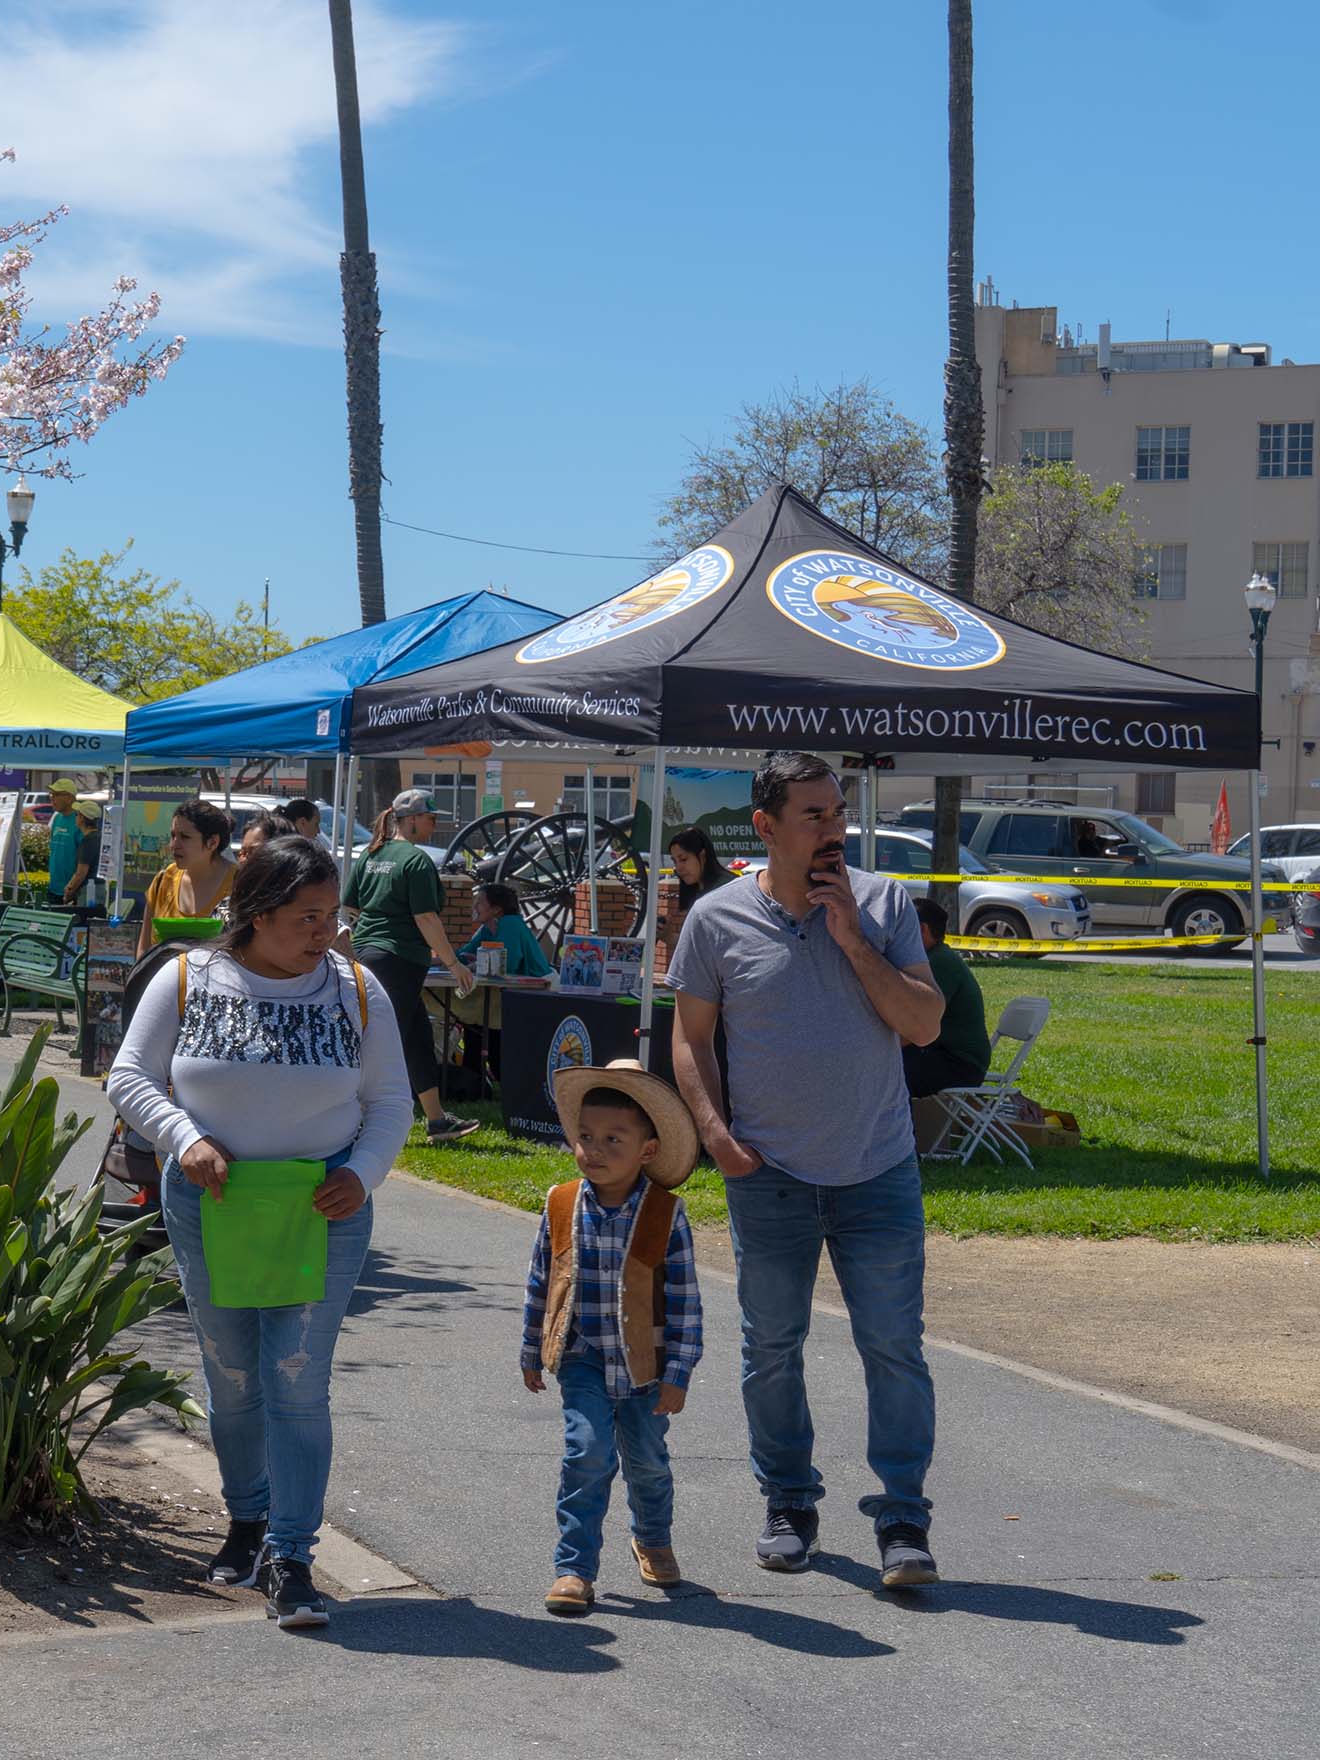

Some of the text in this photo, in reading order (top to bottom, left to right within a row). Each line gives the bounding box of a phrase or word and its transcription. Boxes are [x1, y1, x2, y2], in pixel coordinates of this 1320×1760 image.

[784, 557, 979, 628] CITY of WATSONVILLE
[856, 638, 988, 665] CALIFORNIA
[367, 689, 640, 728] Watsonville Parks & Community Services
[726, 699, 1208, 751] www.watsonvillerec.com
[725, 824, 753, 836] OPEN
[729, 841, 750, 851] CRUZ
